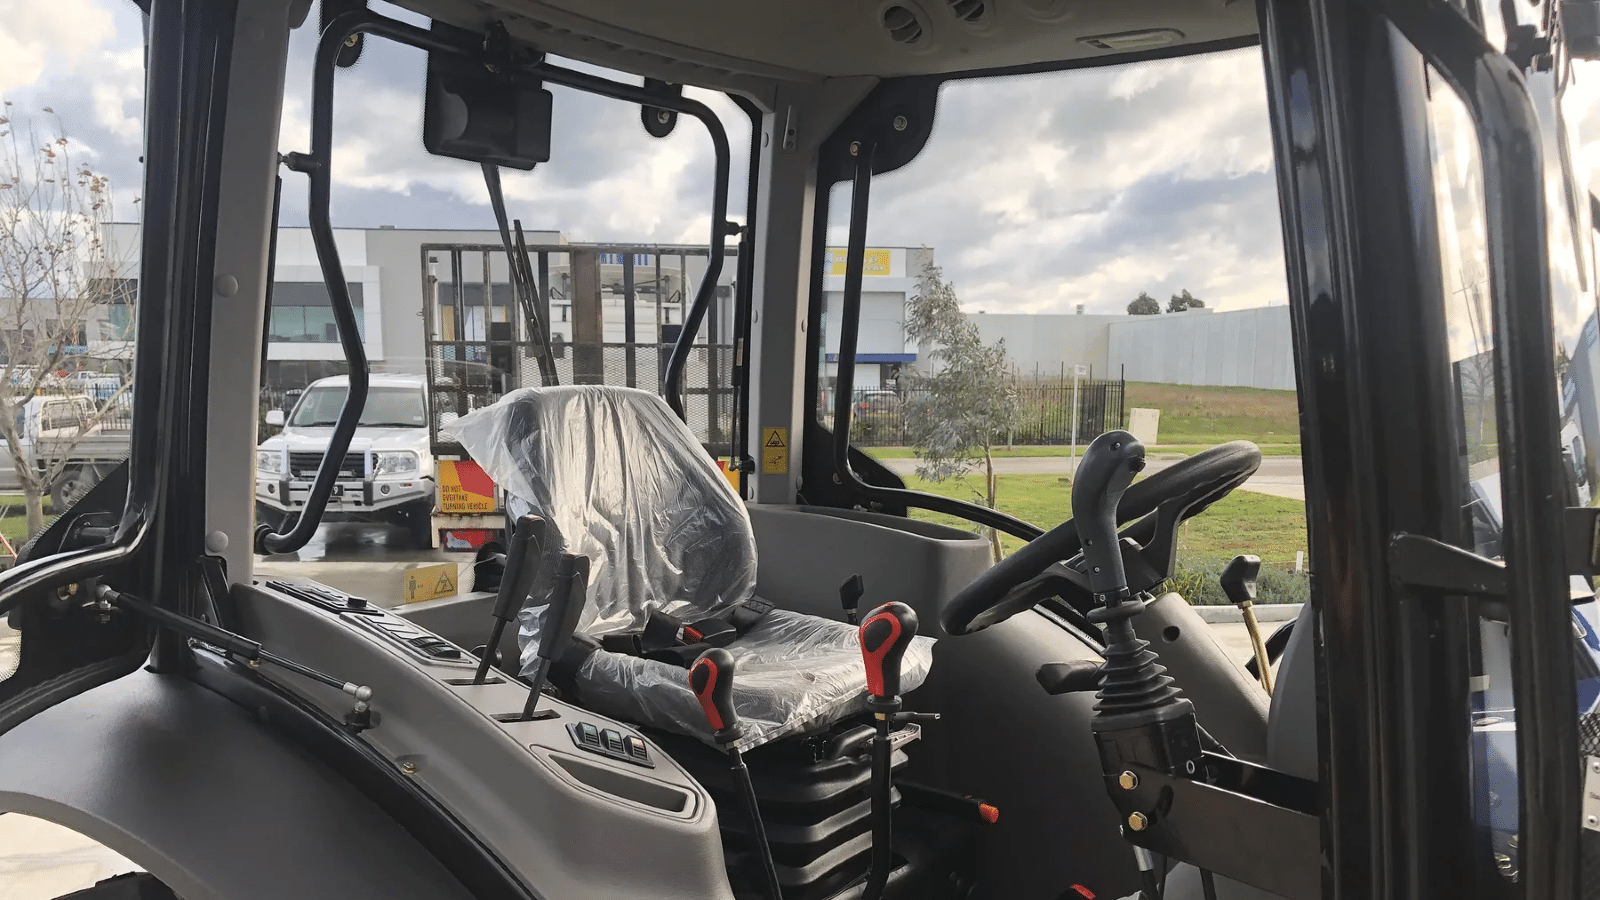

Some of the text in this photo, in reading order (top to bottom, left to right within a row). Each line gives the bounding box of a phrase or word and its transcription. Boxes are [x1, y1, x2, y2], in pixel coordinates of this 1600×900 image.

[442, 493, 468, 501] OVERTAKE
[443, 502, 488, 510] TURNING VEHICLE
